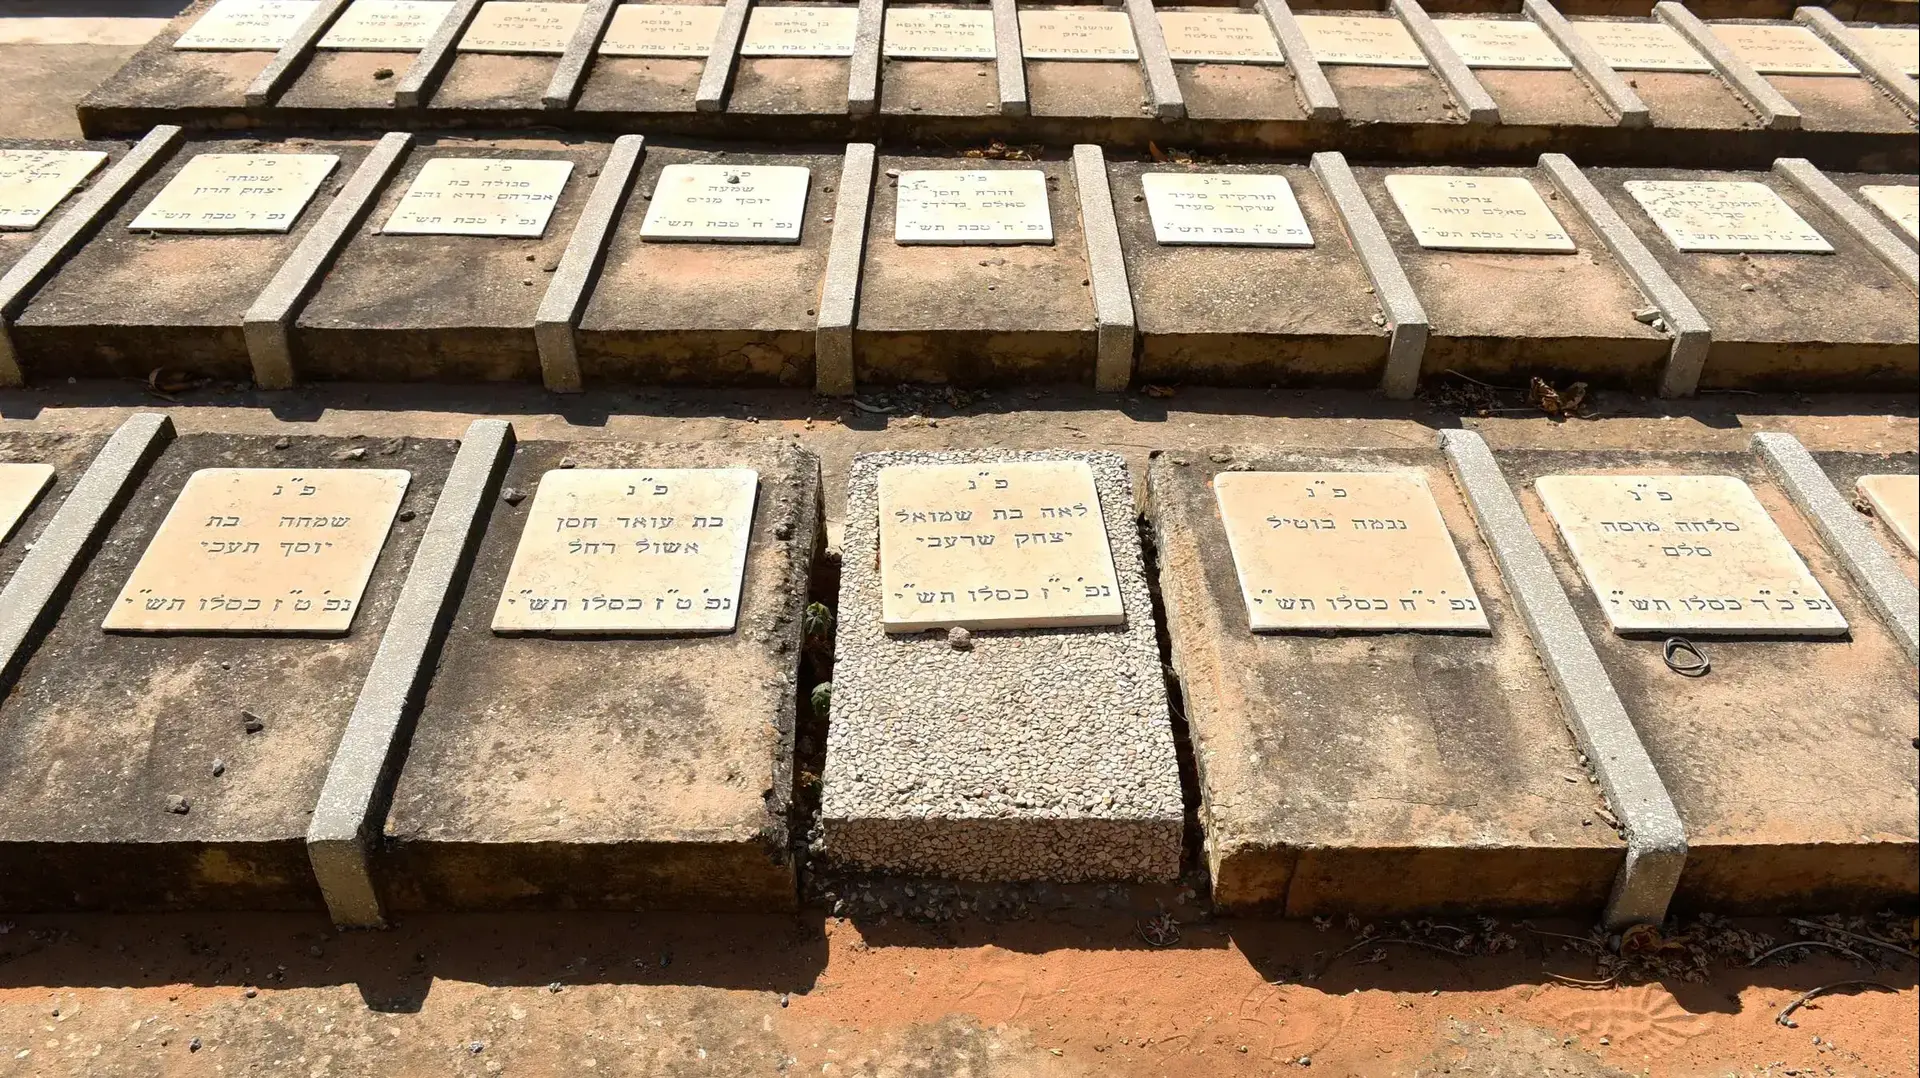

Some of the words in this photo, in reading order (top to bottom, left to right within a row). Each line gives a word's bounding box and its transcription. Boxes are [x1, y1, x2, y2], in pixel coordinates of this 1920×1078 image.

[447, 179, 470, 188] בת
[496, 193, 554, 201] אברהם
[201, 212, 237, 220] טבת
[453, 216, 487, 225] טבת
[706, 220, 740, 228] טבת
[273, 478, 316, 496] פ"נ
[627, 478, 668, 495] פ"נ
[968, 472, 1008, 490] פ"נ
[1306, 481, 1347, 498] פ"נ
[1631, 484, 1672, 501] פ"נ
[895, 509, 972, 523] שמואל
[993, 509, 1023, 520] בת
[1041, 503, 1087, 518] לאה
[205, 516, 239, 527] בת
[279, 517, 350, 527] שמחה
[557, 518, 597, 532] חסן
[692, 517, 723, 528] בת
[1267, 514, 1335, 529] בוטיל
[1600, 522, 1659, 531] מוסה
[1675, 518, 1740, 532] סלחה
[568, 538, 616, 554] רחל
[636, 538, 698, 554] אשול
[916, 535, 995, 548] שרעבי
[1014, 532, 1072, 548] יצחק
[280, 542, 332, 556] יוסף
[894, 584, 954, 603] תש"י
[968, 586, 1028, 601] כסלו
[1041, 578, 1070, 599] י"ז
[1077, 577, 1110, 597] נפ'
[125, 589, 185, 611] תש"י
[200, 595, 261, 611] כסלו
[273, 590, 304, 611] ט"ז
[323, 590, 351, 611] נפ'
[508, 590, 567, 611] תש"י
[582, 594, 642, 611] כסלו
[656, 589, 691, 610] ט"ז
[703, 589, 731, 610] נפ'
[1254, 589, 1315, 610] תש"י
[1326, 594, 1388, 610] כסלו
[1399, 590, 1435, 610] י"ח
[1441, 589, 1478, 610] נפ'
[1611, 590, 1671, 611] תש"י
[1679, 595, 1742, 611] כסלו
[1791, 589, 1833, 610] נפ'
